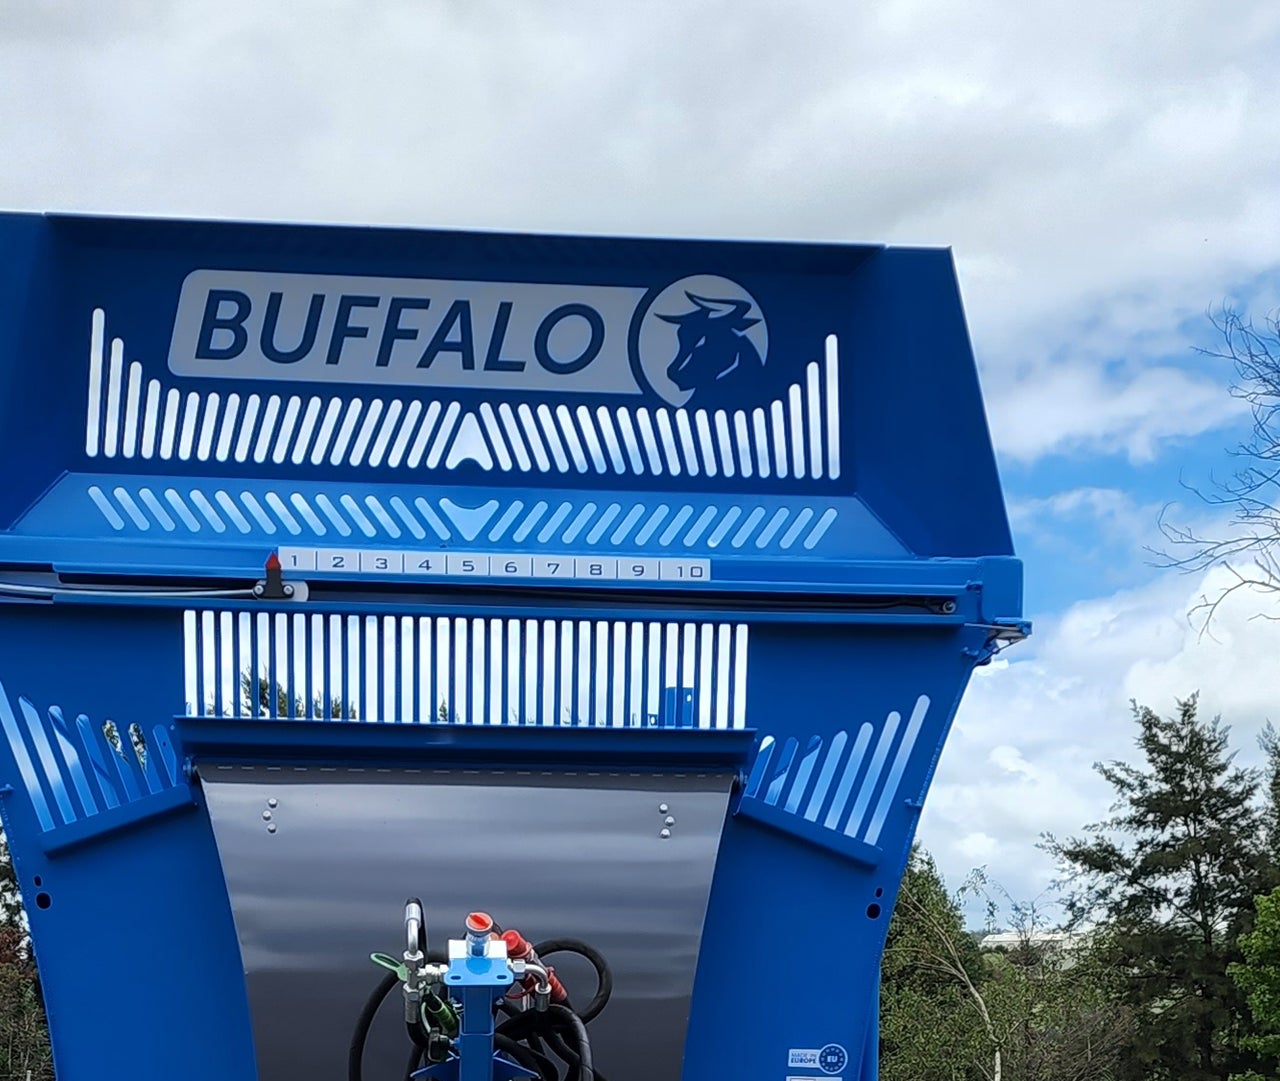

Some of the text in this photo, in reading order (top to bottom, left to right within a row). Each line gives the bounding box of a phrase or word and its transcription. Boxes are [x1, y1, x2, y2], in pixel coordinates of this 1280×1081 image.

[194, 288, 606, 376] BUFFALO
[331, 556, 345, 569] 2
[375, 557, 388, 570] 3
[417, 559, 433, 572] 4
[462, 560, 475, 573] 5
[504, 561, 518, 574] 6
[547, 562, 561, 575] 7
[589, 563, 603, 576] 8
[631, 564, 645, 577] 9
[677, 565, 704, 578] 10
[827, 1055, 838, 1063] EU
